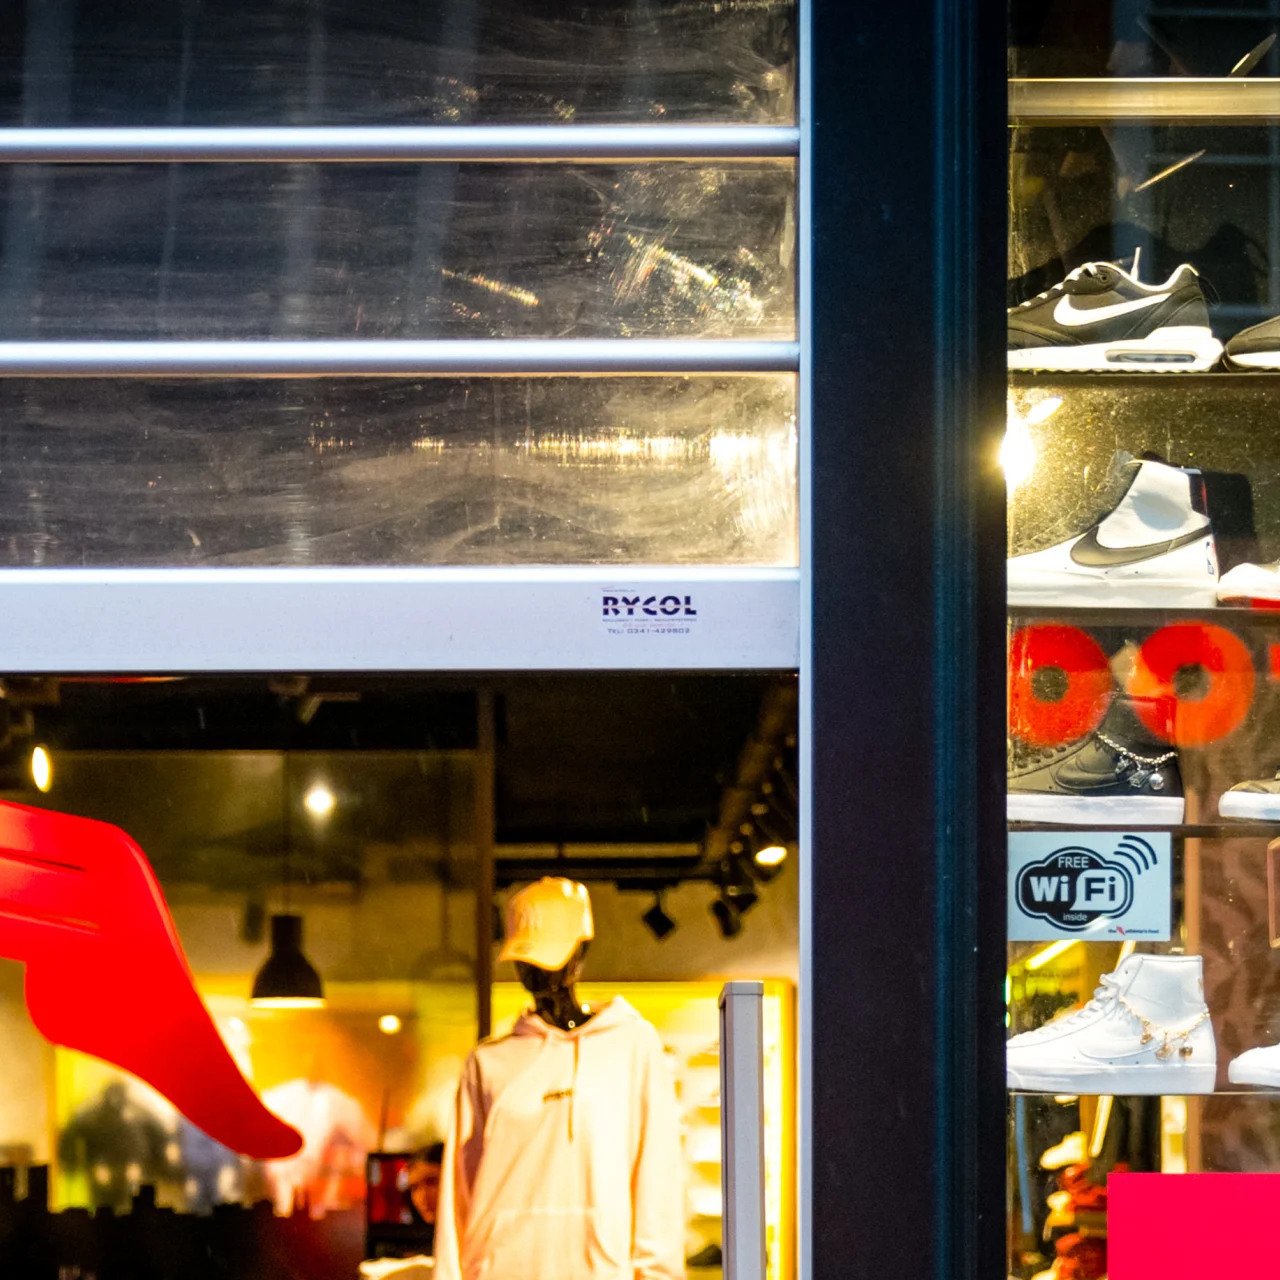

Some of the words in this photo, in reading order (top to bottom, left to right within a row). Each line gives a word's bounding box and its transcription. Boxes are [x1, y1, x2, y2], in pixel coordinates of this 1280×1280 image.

[602, 595, 697, 616] RYCOL
[1058, 856, 1089, 868] FREE
[1062, 912, 1088, 922] inside
